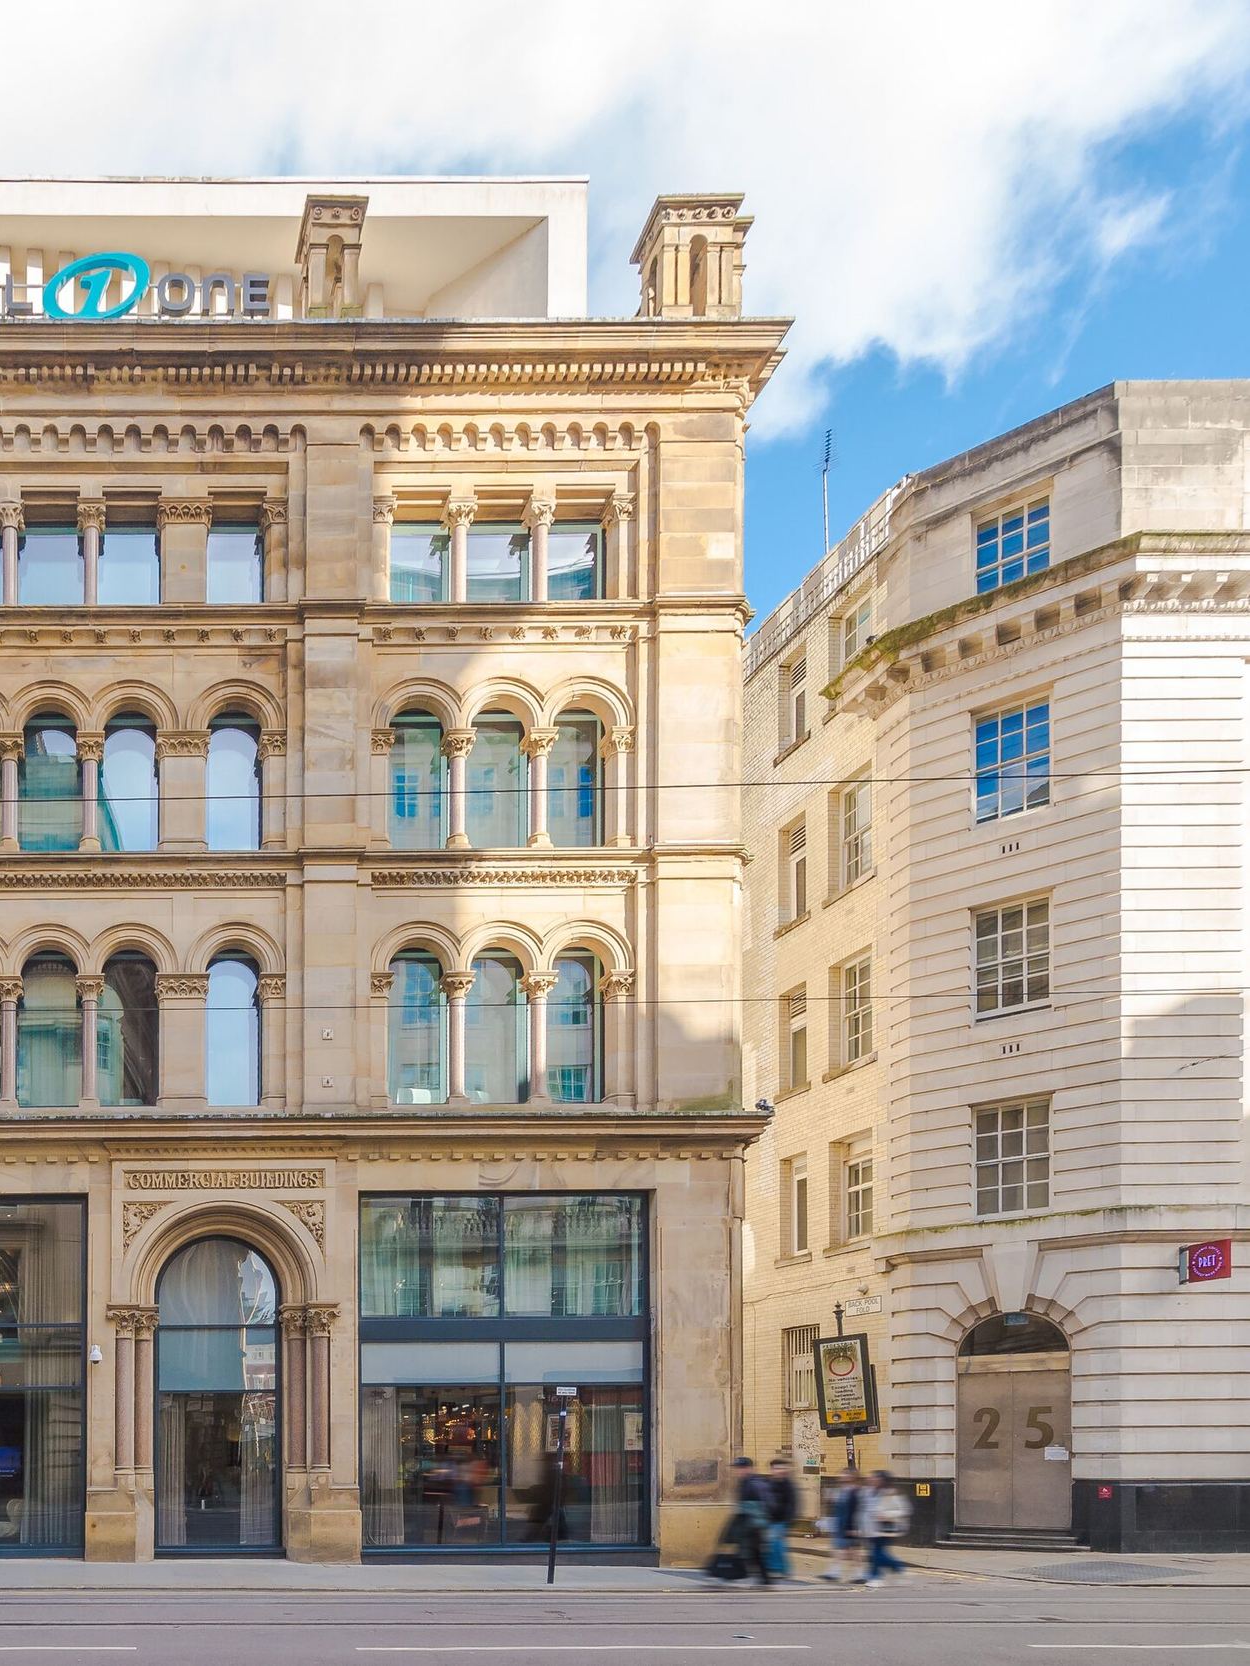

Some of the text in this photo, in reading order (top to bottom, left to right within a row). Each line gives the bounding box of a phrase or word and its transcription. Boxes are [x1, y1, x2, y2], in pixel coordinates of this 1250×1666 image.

[128, 1170, 320, 1190] COMMERCIAL BUILDINGS
[1198, 1254, 1216, 1268] PRET
